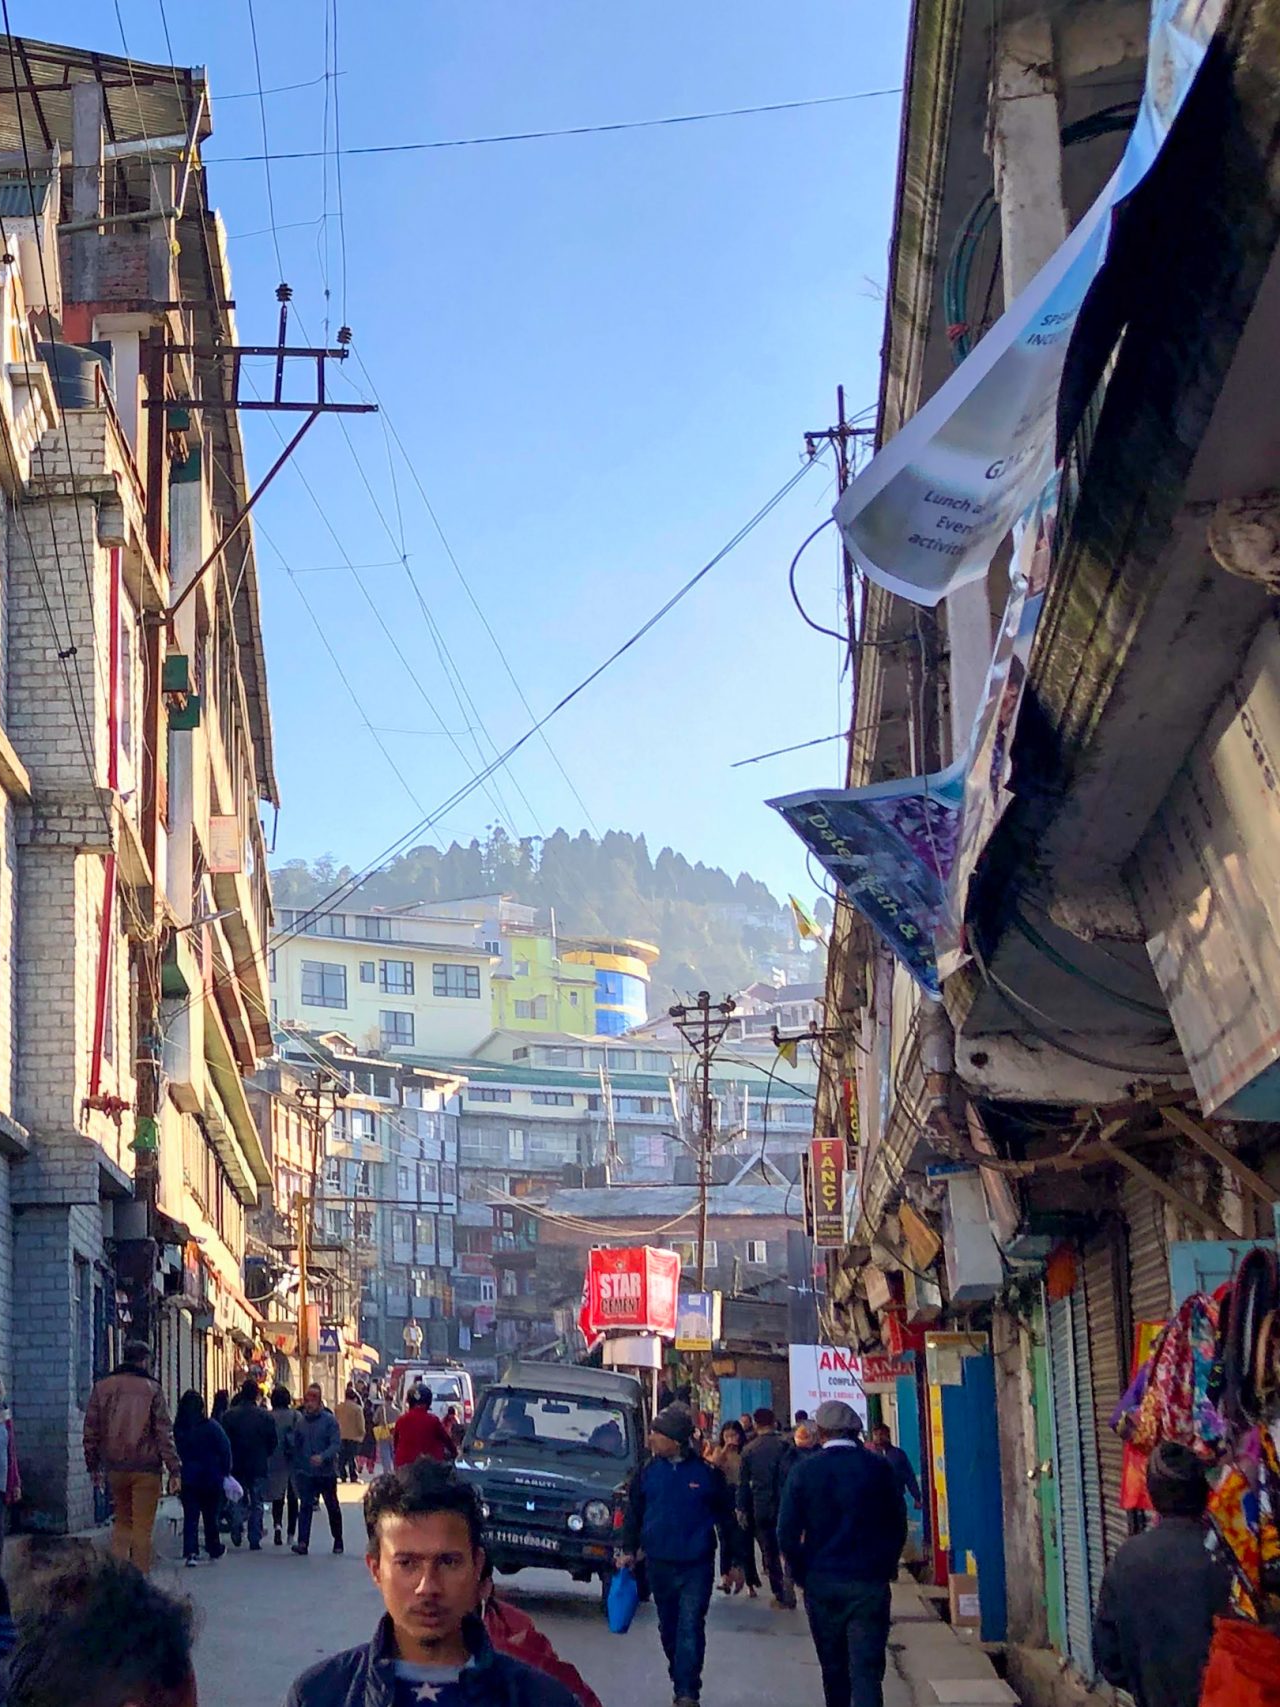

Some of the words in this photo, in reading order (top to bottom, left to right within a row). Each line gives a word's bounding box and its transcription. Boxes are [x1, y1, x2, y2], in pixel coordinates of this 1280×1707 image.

[923, 490, 971, 513] Lunch
[808, 814, 853, 860] Date
[820, 1142, 837, 1212] FANCY
[599, 1272, 642, 1299] STAR
[601, 1298, 641, 1314] CEMENT
[514, 1477, 556, 1489] MARUTI
